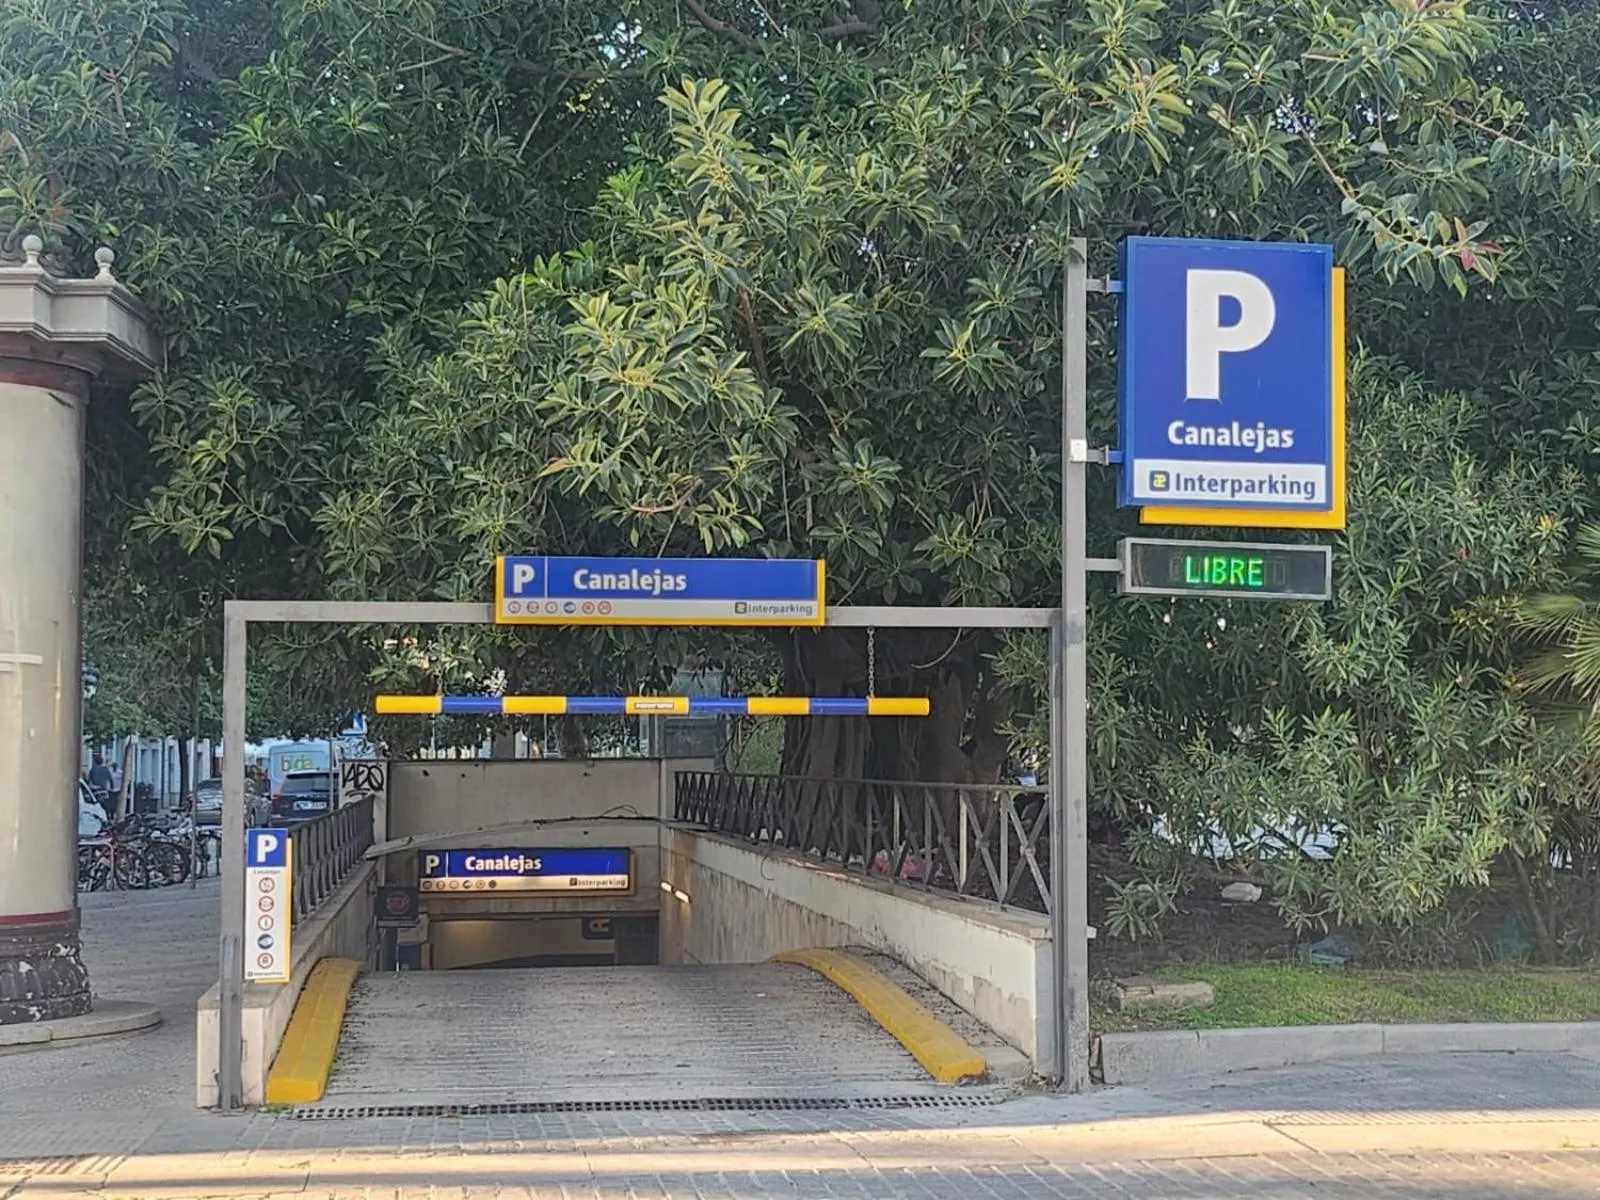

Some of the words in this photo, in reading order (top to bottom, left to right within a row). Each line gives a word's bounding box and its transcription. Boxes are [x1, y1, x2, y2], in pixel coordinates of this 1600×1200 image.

[1187, 269, 1276, 399] P
[1167, 420, 1294, 453] Canalejas
[1175, 473, 1316, 500] Interparking
[513, 564, 535, 593] P
[573, 569, 687, 595] Canalejas
[1185, 556, 1264, 586] LIBRE
[257, 834, 278, 862] P
[425, 855, 440, 874] P
[465, 855, 542, 873] Canalejas
